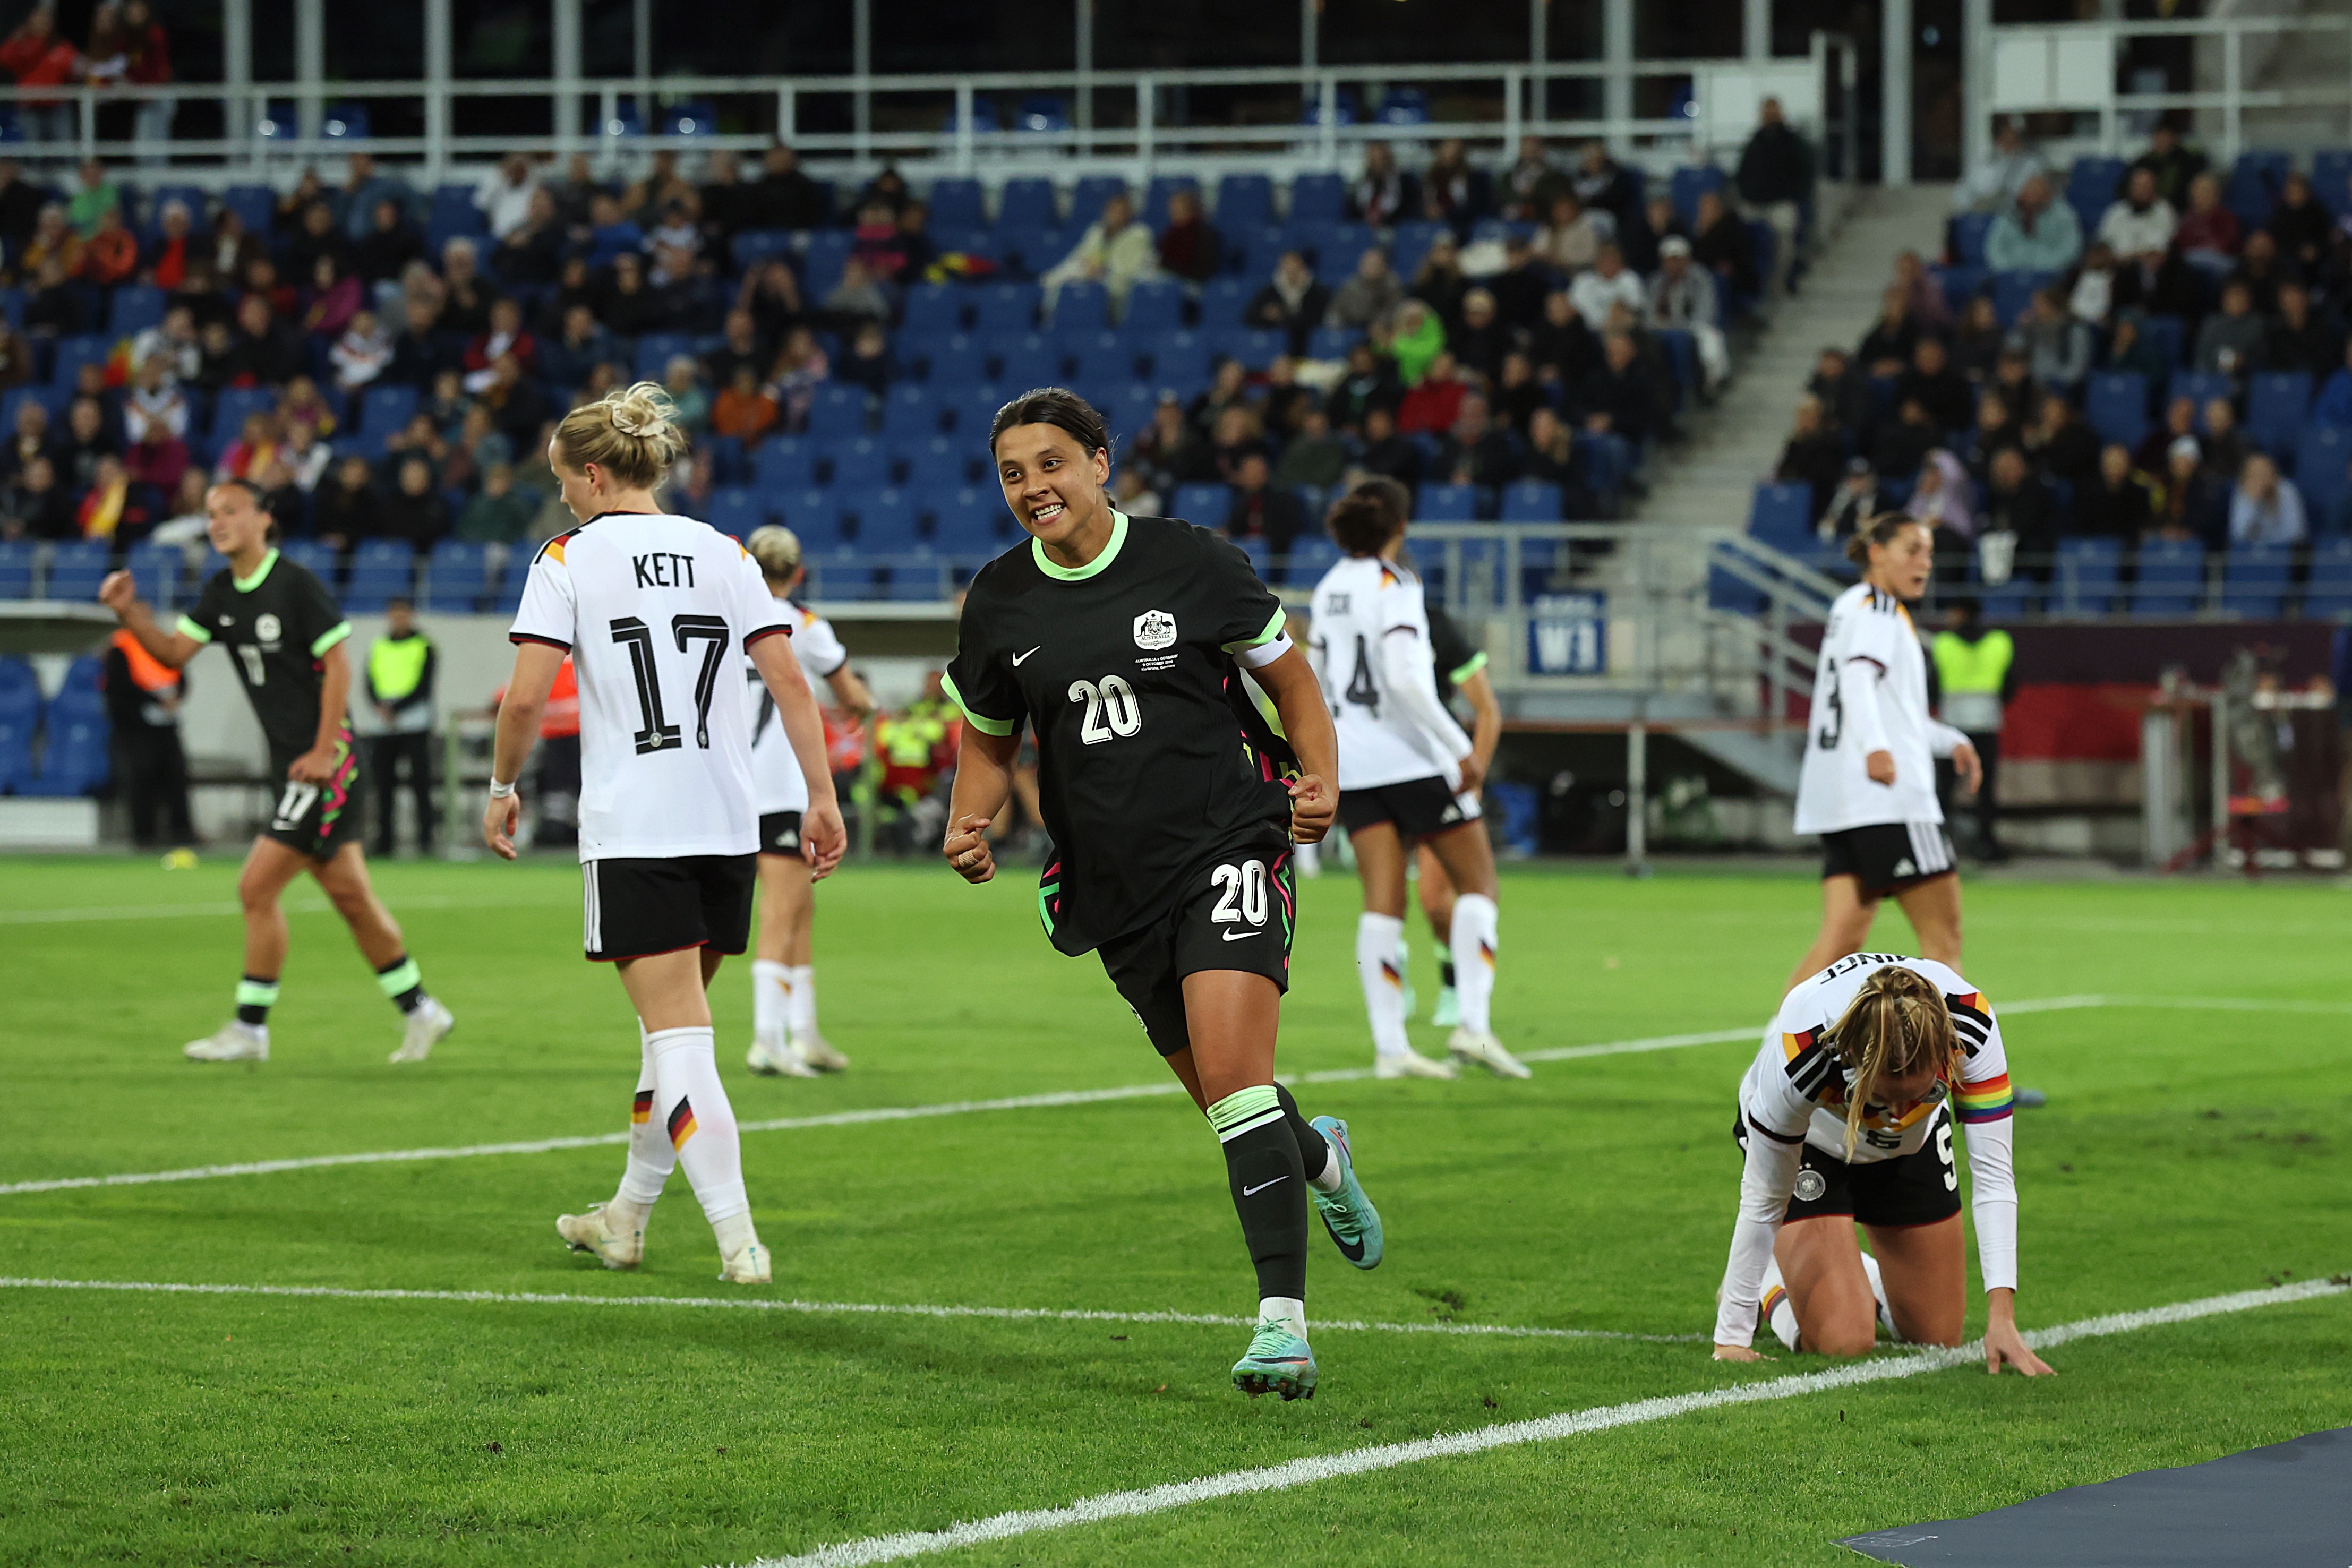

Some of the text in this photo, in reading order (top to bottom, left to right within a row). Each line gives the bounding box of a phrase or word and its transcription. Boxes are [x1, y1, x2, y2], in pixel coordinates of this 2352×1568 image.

[633, 553, 694, 588] KETT
[610, 614, 730, 755] 17
[1068, 675, 1142, 746] 20
[1211, 859, 1268, 926] 20
[1817, 954, 1924, 984] INGE
[1936, 1122, 1958, 1192] 5
